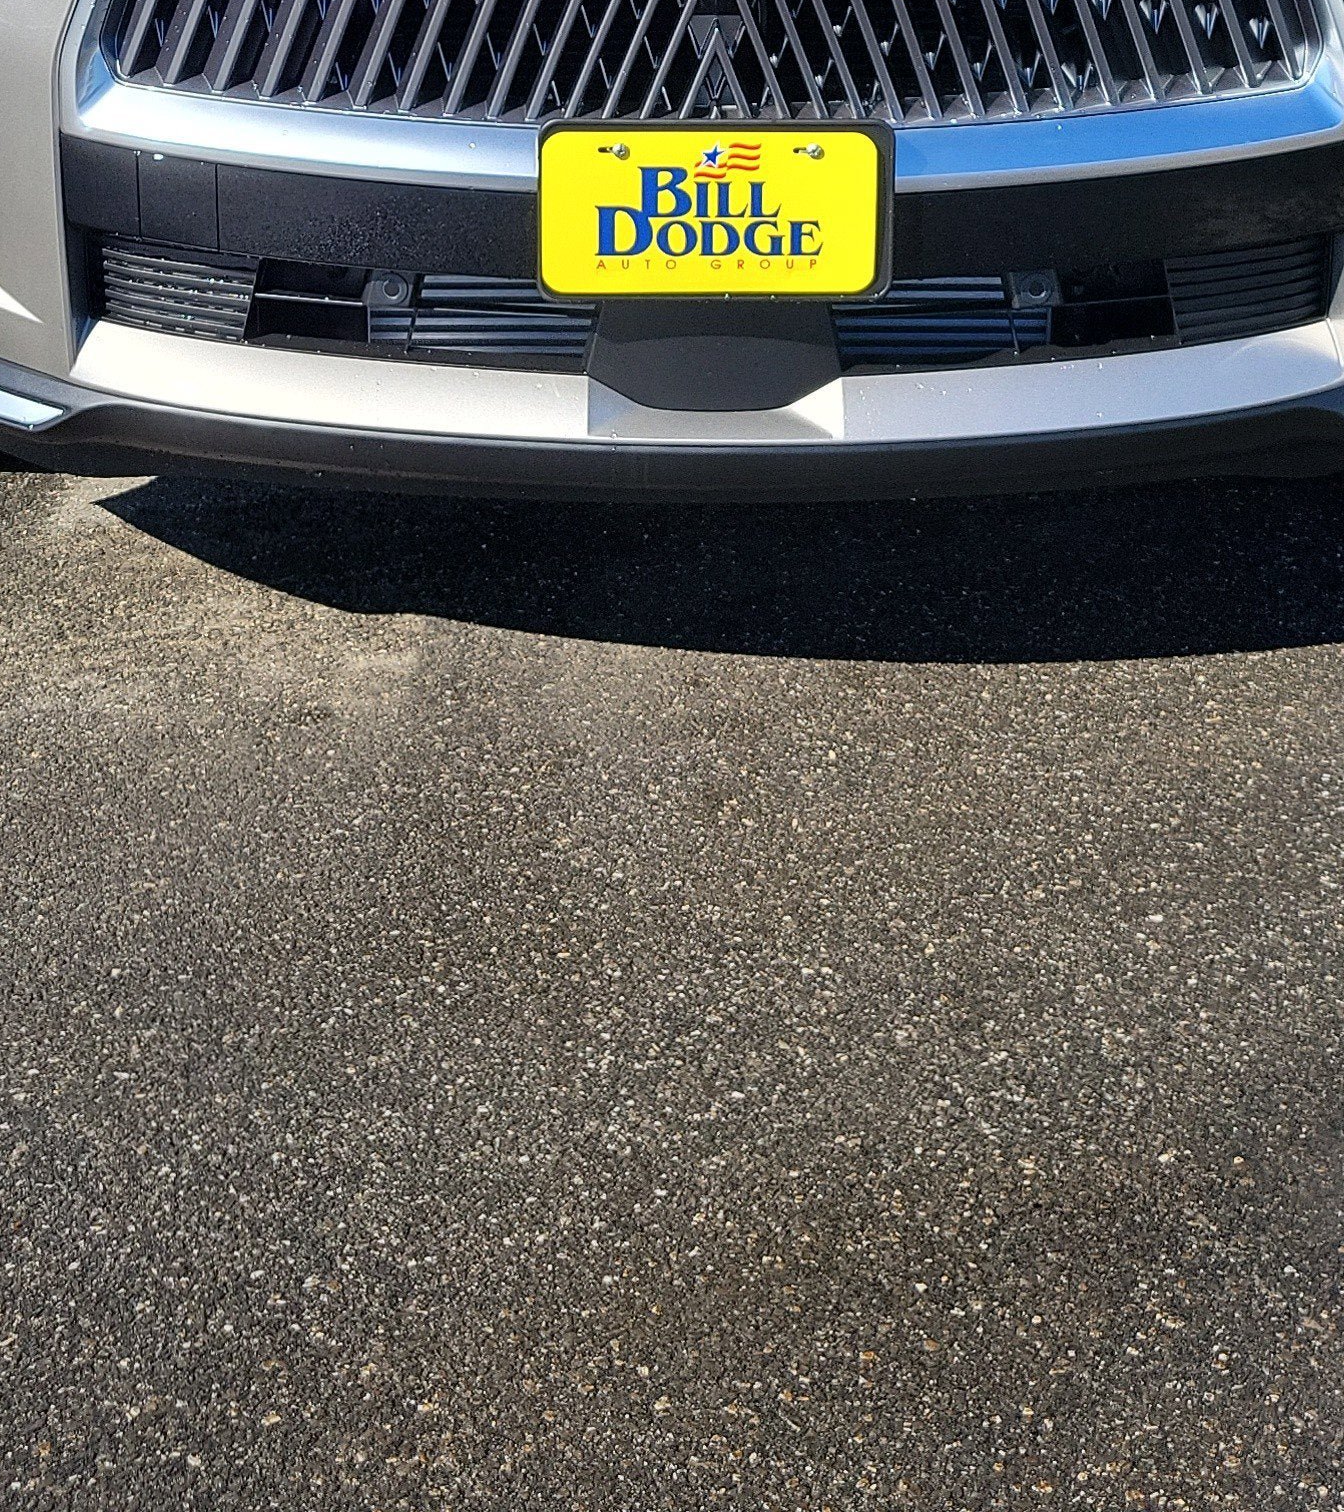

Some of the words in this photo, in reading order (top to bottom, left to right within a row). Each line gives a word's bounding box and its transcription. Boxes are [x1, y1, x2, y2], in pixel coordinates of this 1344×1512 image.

[638, 166, 783, 219] BILL
[595, 205, 824, 256] DODGE
[596, 259, 677, 270] AUTO
[710, 259, 818, 270] GROUP
